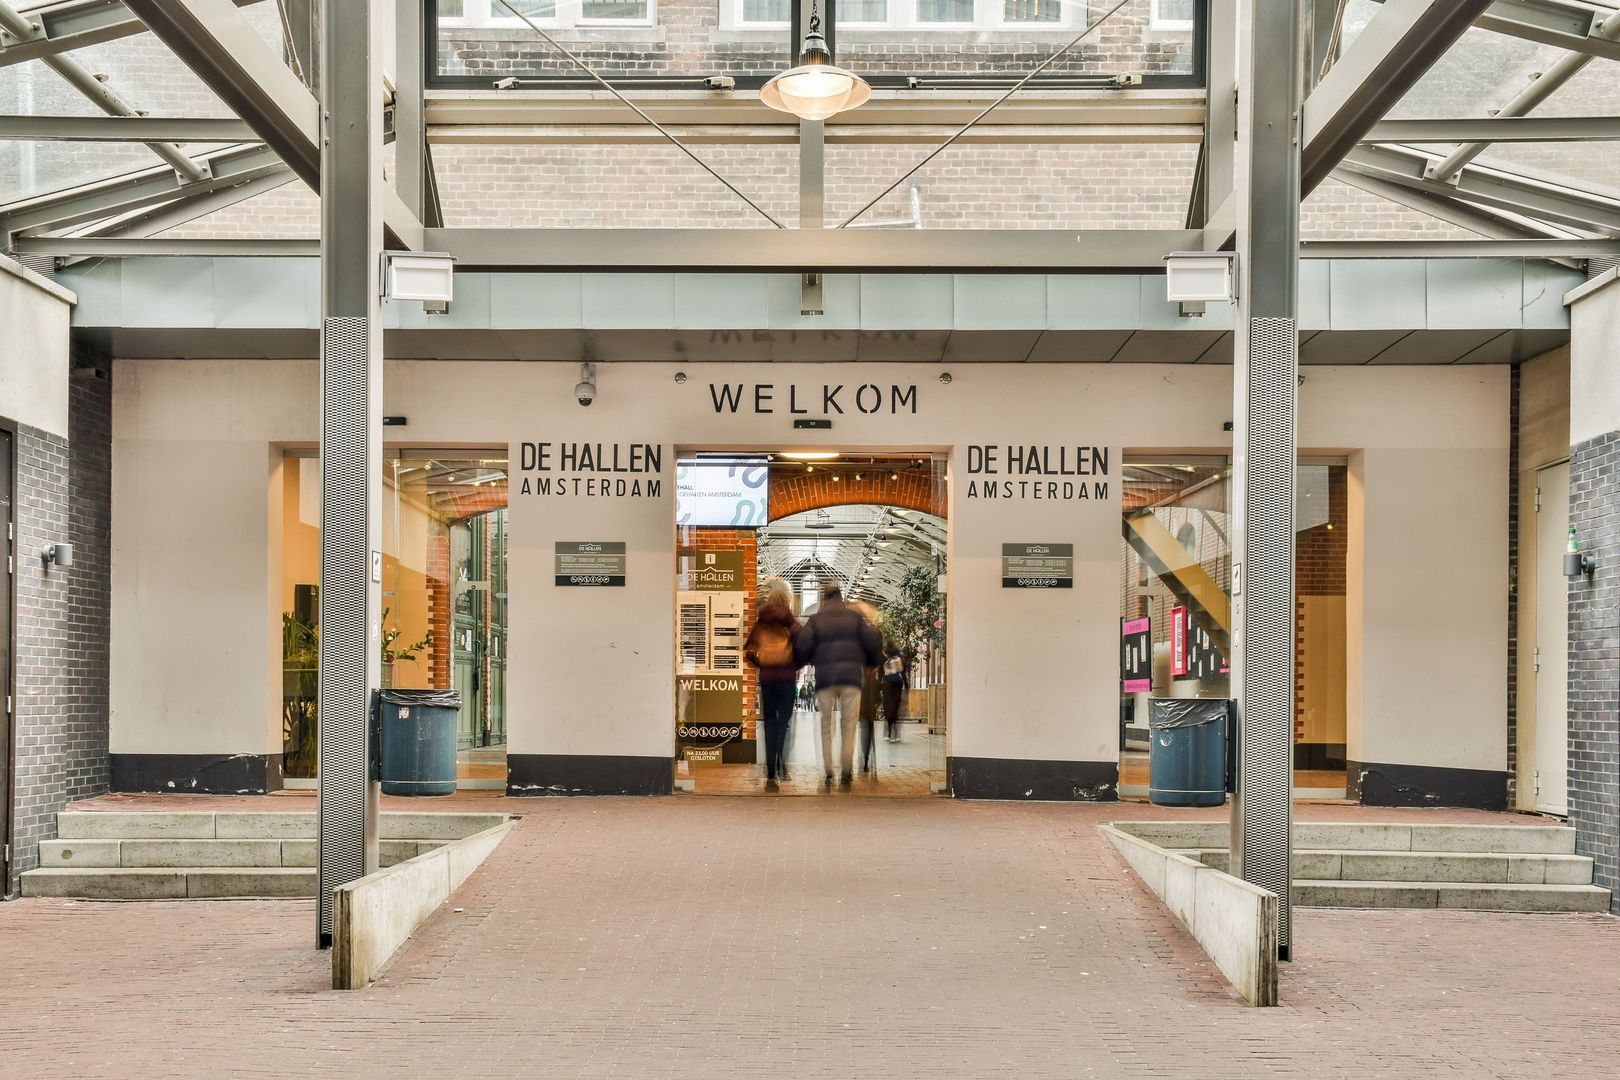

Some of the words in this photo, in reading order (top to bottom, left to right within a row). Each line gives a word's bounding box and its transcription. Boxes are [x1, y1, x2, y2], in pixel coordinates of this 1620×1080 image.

[709, 384, 917, 414] WELKOM
[521, 442, 552, 473] DE
[560, 443, 661, 474] HALLEN
[967, 445, 998, 474] DE
[1007, 445, 1108, 476] HALLEN
[521, 478, 661, 498] AMSTERDAM
[967, 481, 1108, 500] AMSTERDAM
[700, 572, 734, 582] HALLEN
[680, 679, 739, 691] WELKOM
